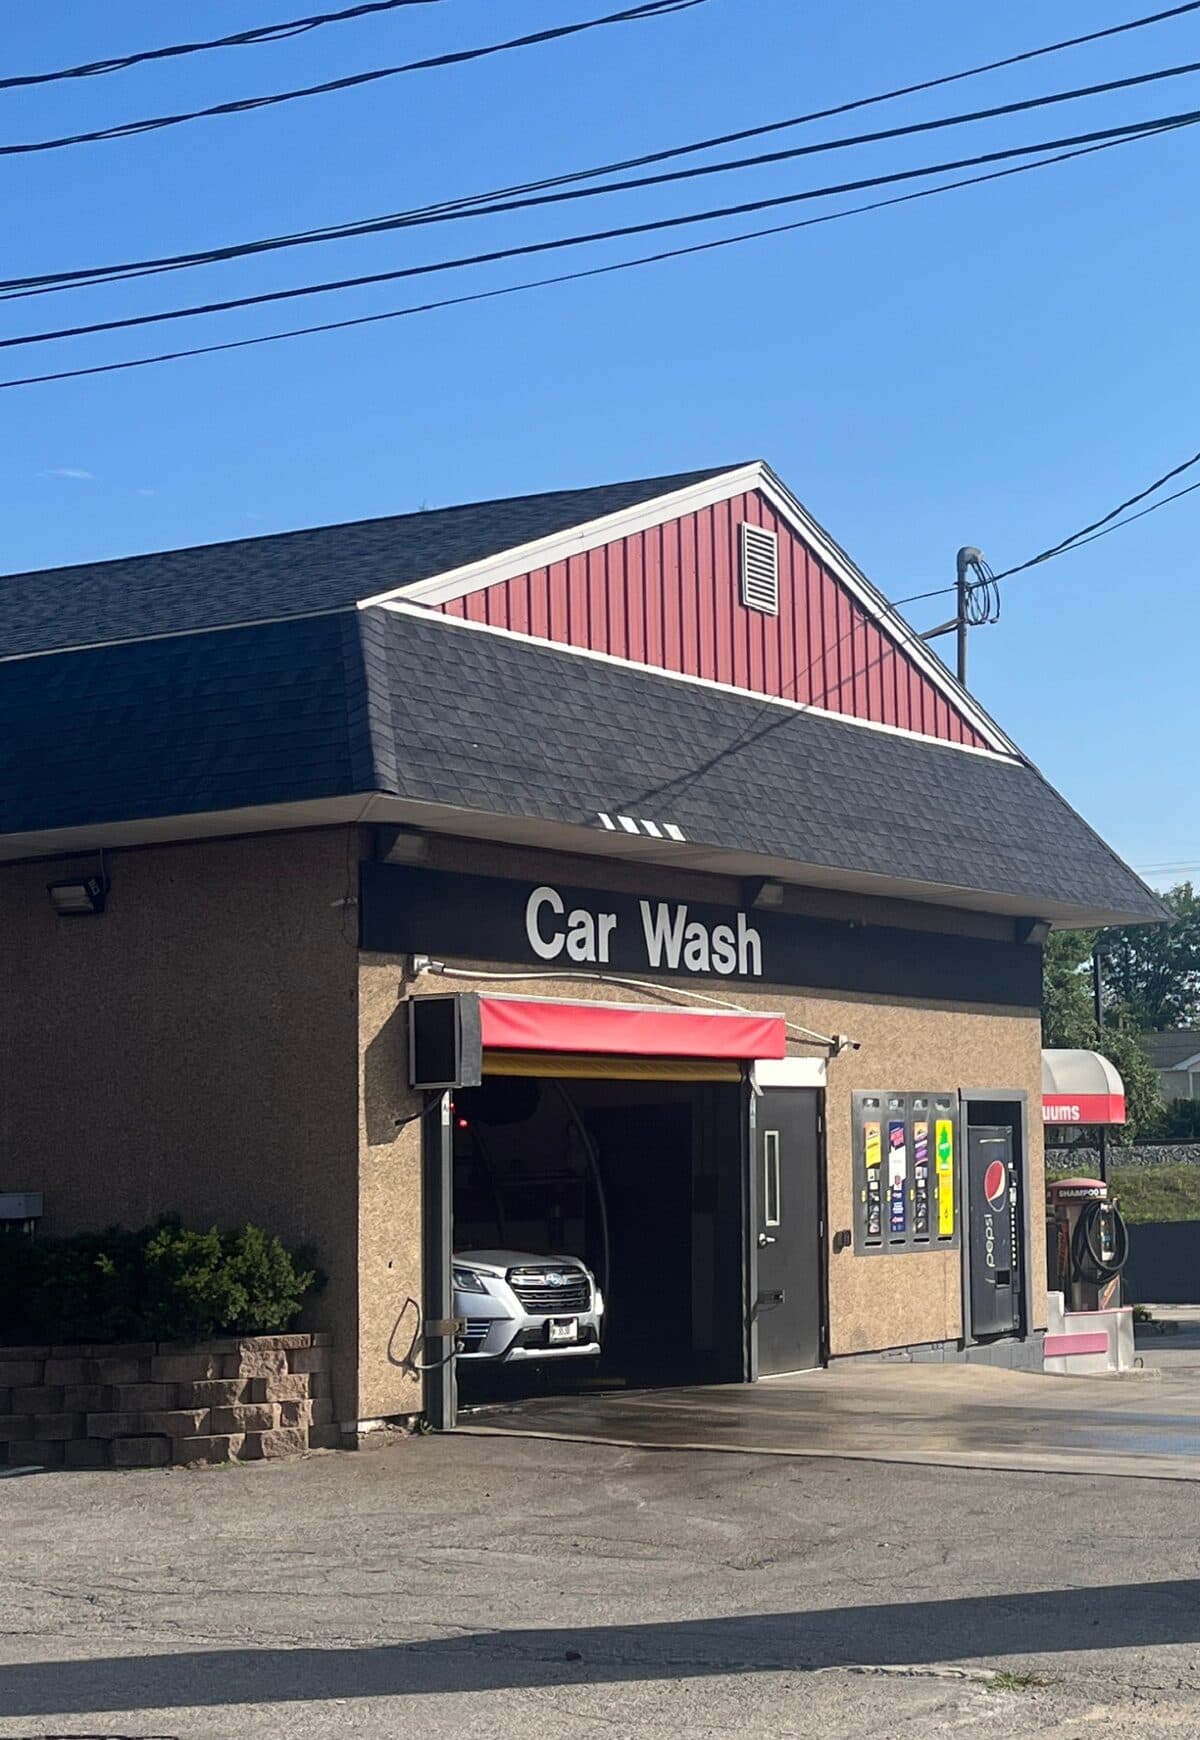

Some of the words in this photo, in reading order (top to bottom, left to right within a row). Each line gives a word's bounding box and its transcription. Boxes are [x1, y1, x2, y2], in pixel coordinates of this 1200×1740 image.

[525, 885, 617, 964] Car
[639, 899, 763, 976] Wash
[983, 1213, 996, 1268] pepsi
